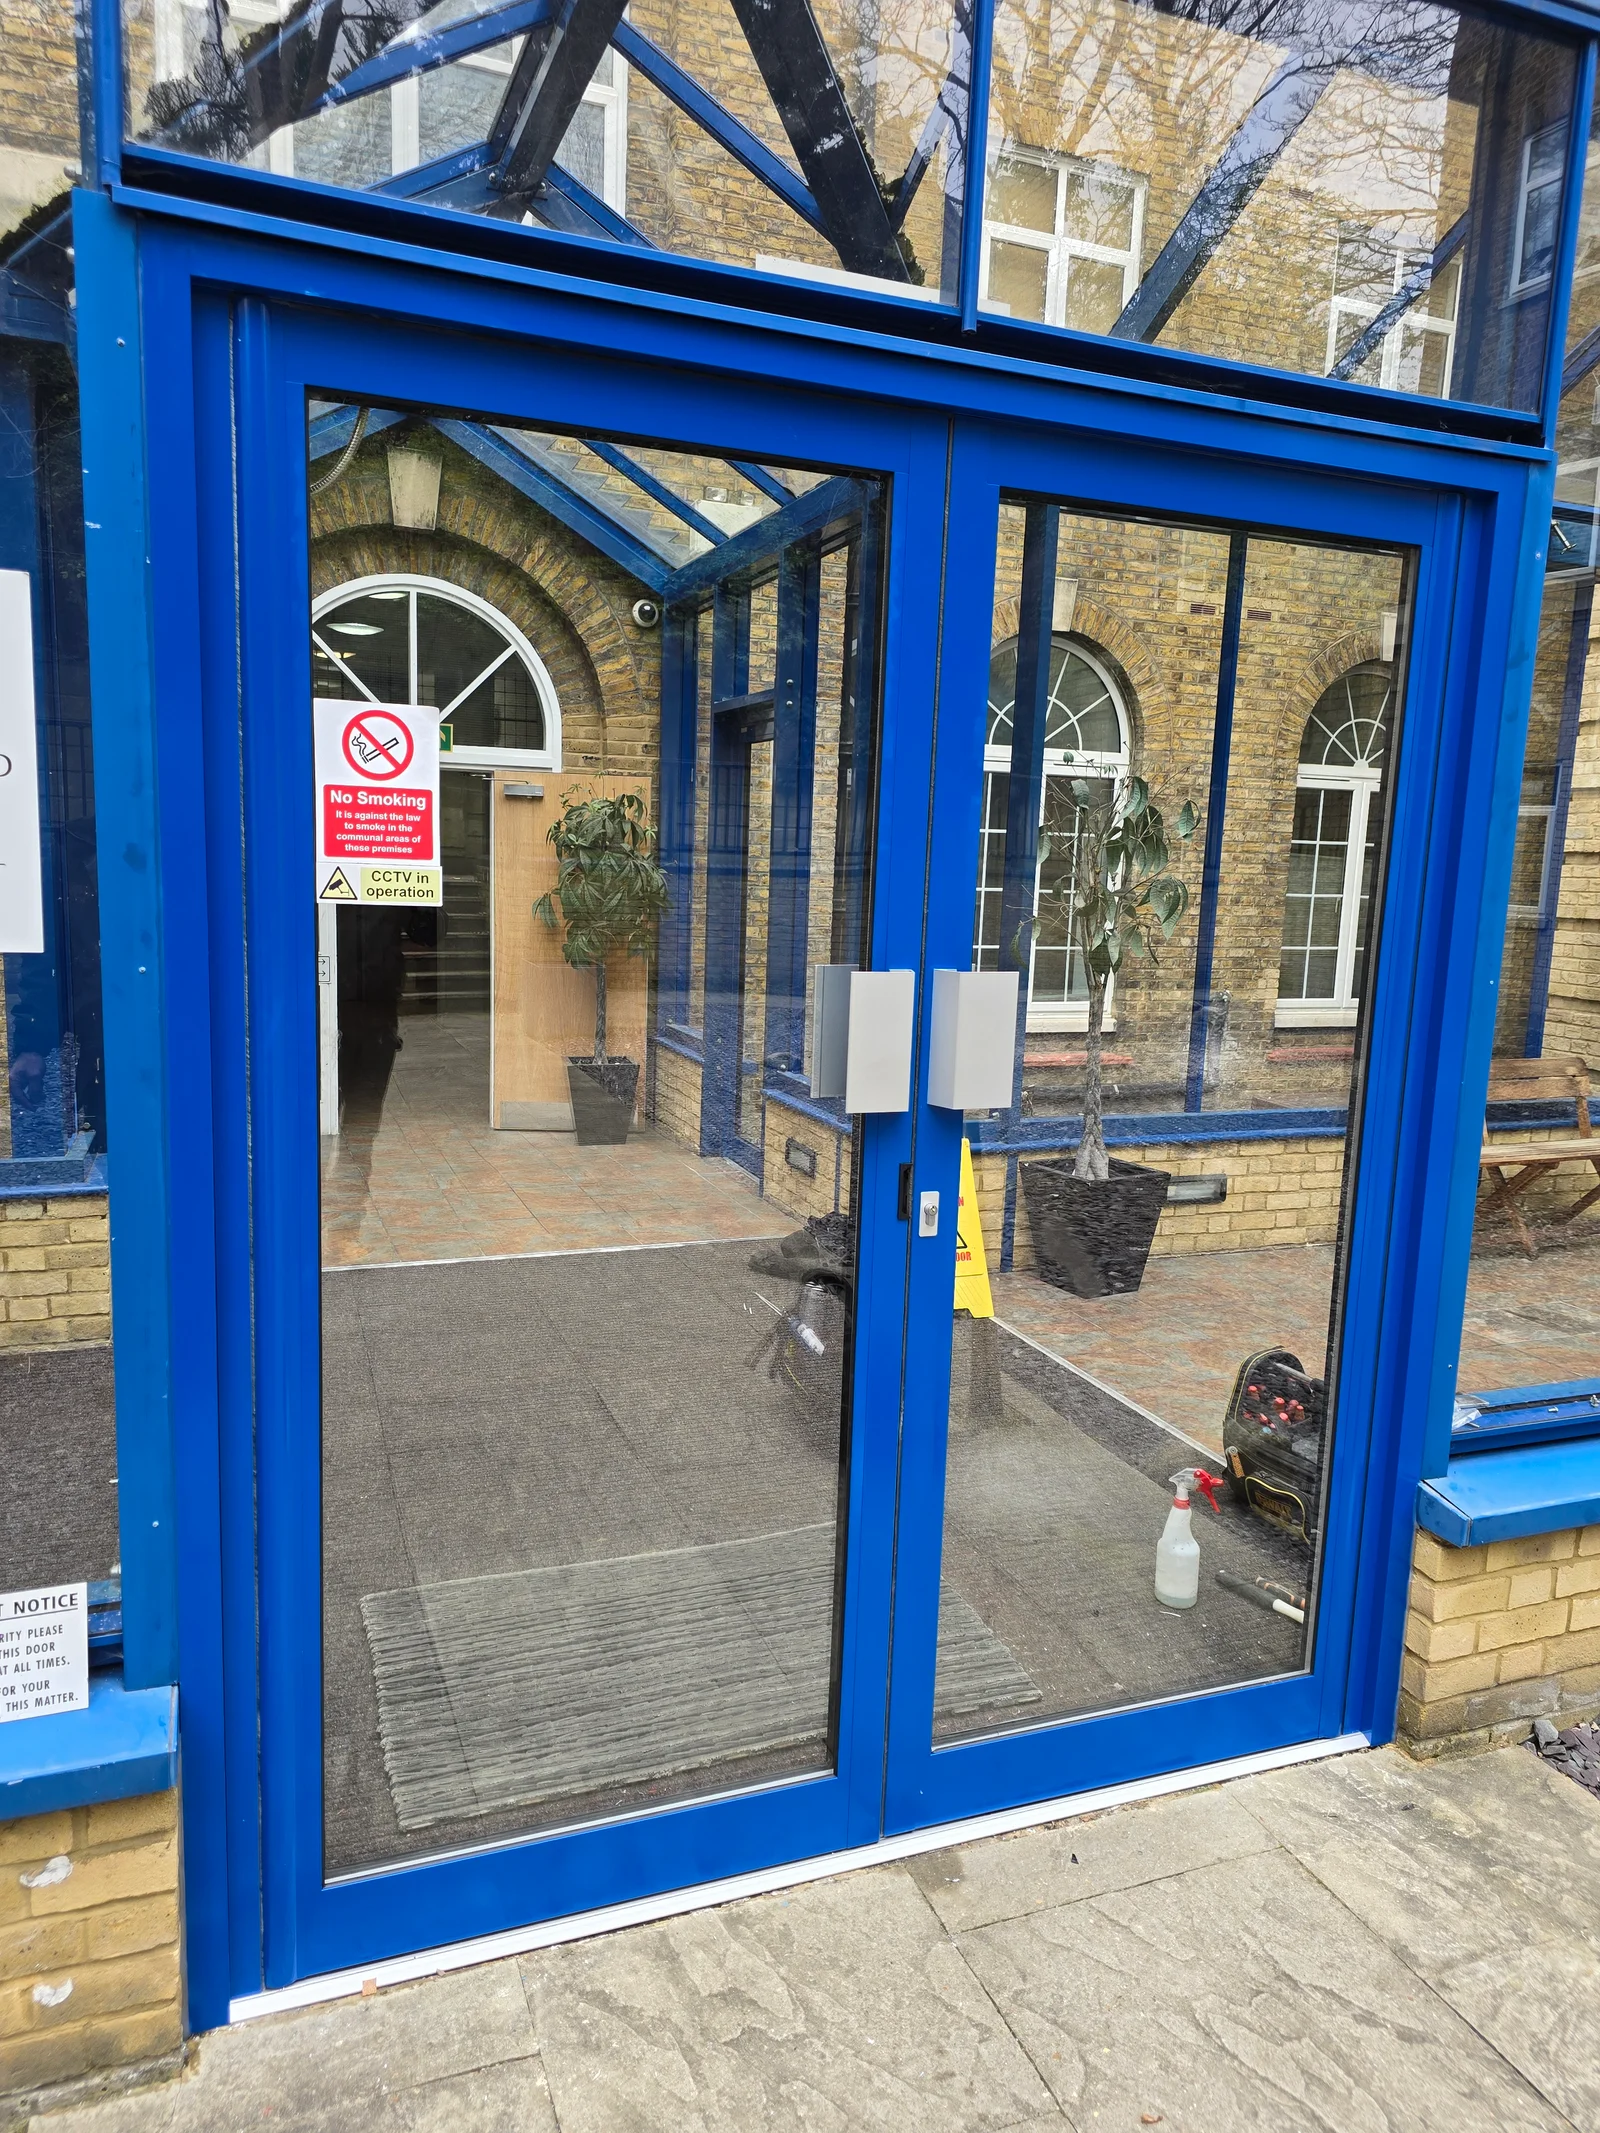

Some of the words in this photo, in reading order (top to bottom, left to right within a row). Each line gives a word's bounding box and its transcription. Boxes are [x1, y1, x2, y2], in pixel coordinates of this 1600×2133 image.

[330, 790, 352, 804] No
[357, 791, 426, 810] Smoking
[336, 810, 343, 818] It
[344, 810, 352, 819] is
[354, 811, 388, 822] against
[389, 812, 404, 821] the
[405, 813, 421, 822] law
[344, 822, 354, 830] to
[355, 822, 386, 831] smoke
[388, 823, 397, 832] in
[398, 823, 413, 832] the
[336, 832, 383, 842] communal
[385, 834, 410, 843] areas
[411, 834, 421, 843] of
[344, 844, 370, 852] these
[371, 844, 413, 854] premises
[371, 870, 412, 883] CCTV
[416, 872, 429, 884] in
[366, 886, 434, 899] operation
[14, 1593, 78, 1615] NOTICE
[27, 1624, 63, 1639] PLEASE
[26, 1641, 55, 1656] DOOR
[13, 1662, 31, 1674] ALL
[36, 1656, 70, 1670] TIMES.
[0, 1685, 16, 1697] OR
[22, 1679, 50, 1693] YOUR
[6, 1699, 29, 1712] THIS
[34, 1692, 78, 1708] MATTER.
